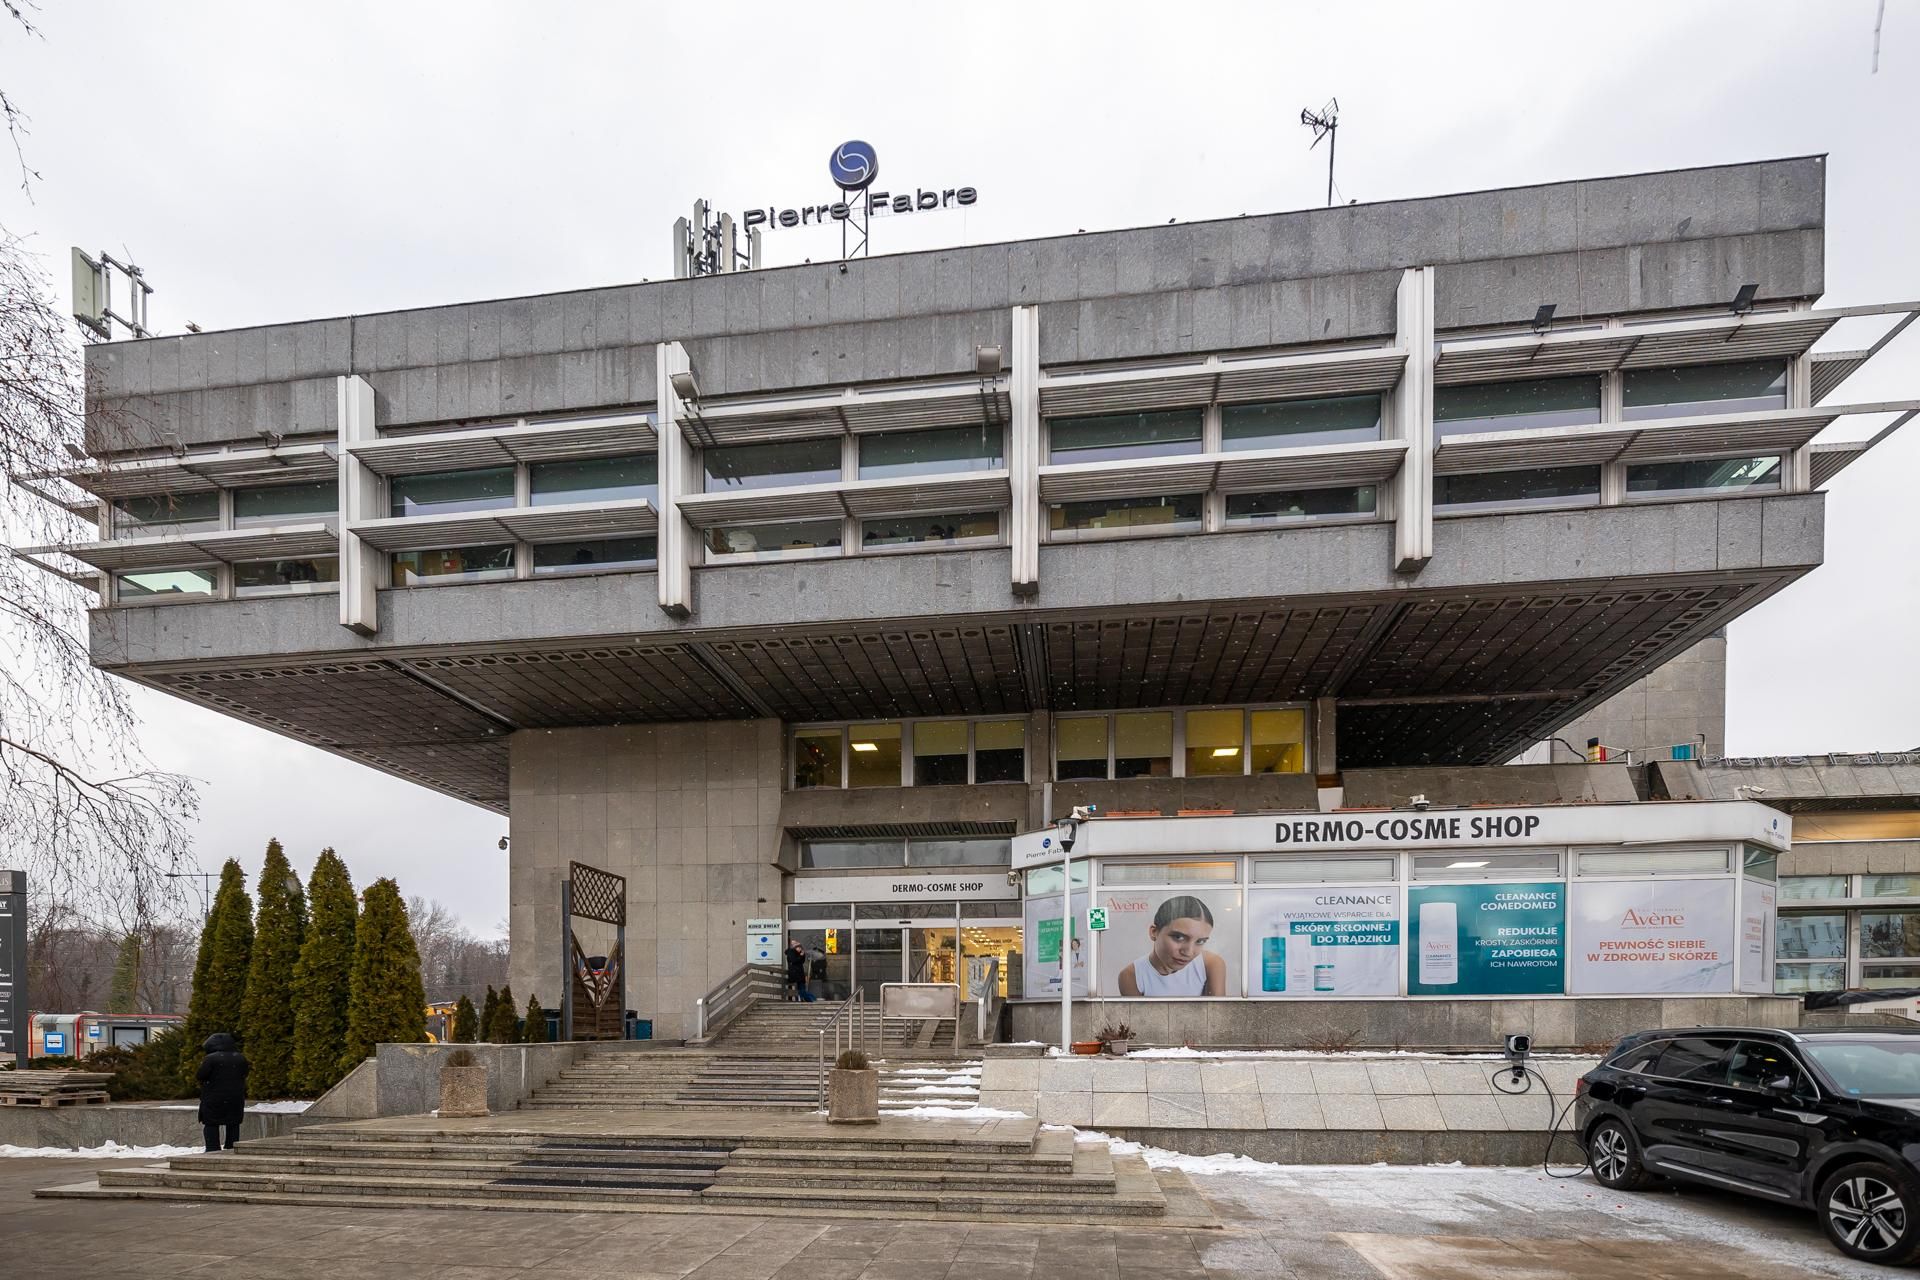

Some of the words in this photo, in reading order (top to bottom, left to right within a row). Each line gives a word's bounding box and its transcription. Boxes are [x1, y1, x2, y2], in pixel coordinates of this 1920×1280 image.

[743, 201, 851, 232] Pierre
[868, 186, 978, 216] Fabre
[1700, 754, 1808, 768] Pierre
[1275, 817, 1461, 843] DERMO-COSME
[1470, 815, 1540, 838] SHOP
[892, 883, 957, 892] DERMO-COSME
[959, 882, 984, 891] SHOP
[1315, 895, 1392, 906] CLEANANCE
[1495, 892, 1557, 901] CLEANANCE
[1106, 897, 1149, 910] Avène
[1480, 901, 1557, 911] COMEDOMED
[1283, 911, 1331, 920] WYJĄTKOWE
[1334, 911, 1374, 919] WSPARCIE
[1621, 908, 1685, 926] Avène
[1294, 922, 1331, 933] SKÓRY
[1333, 923, 1391, 932] SKŁONNEJ
[1497, 927, 1558, 936] REDUKUJE
[1316, 935, 1333, 943] DO
[1336, 934, 1392, 945] TRĄDZIKU
[1475, 939, 1508, 947] KROSTY,
[1509, 937, 1558, 946] ZASKÓRNIKI
[1599, 938, 1665, 950] PEWNOŚĆ
[1667, 940, 1706, 949] SIEBIE
[1491, 949, 1557, 958] ZAPOBIEGA
[1587, 953, 1600, 962] W
[1603, 953, 1665, 962] ZDROWEJ
[1668, 951, 1719, 961] SKÓRZE
